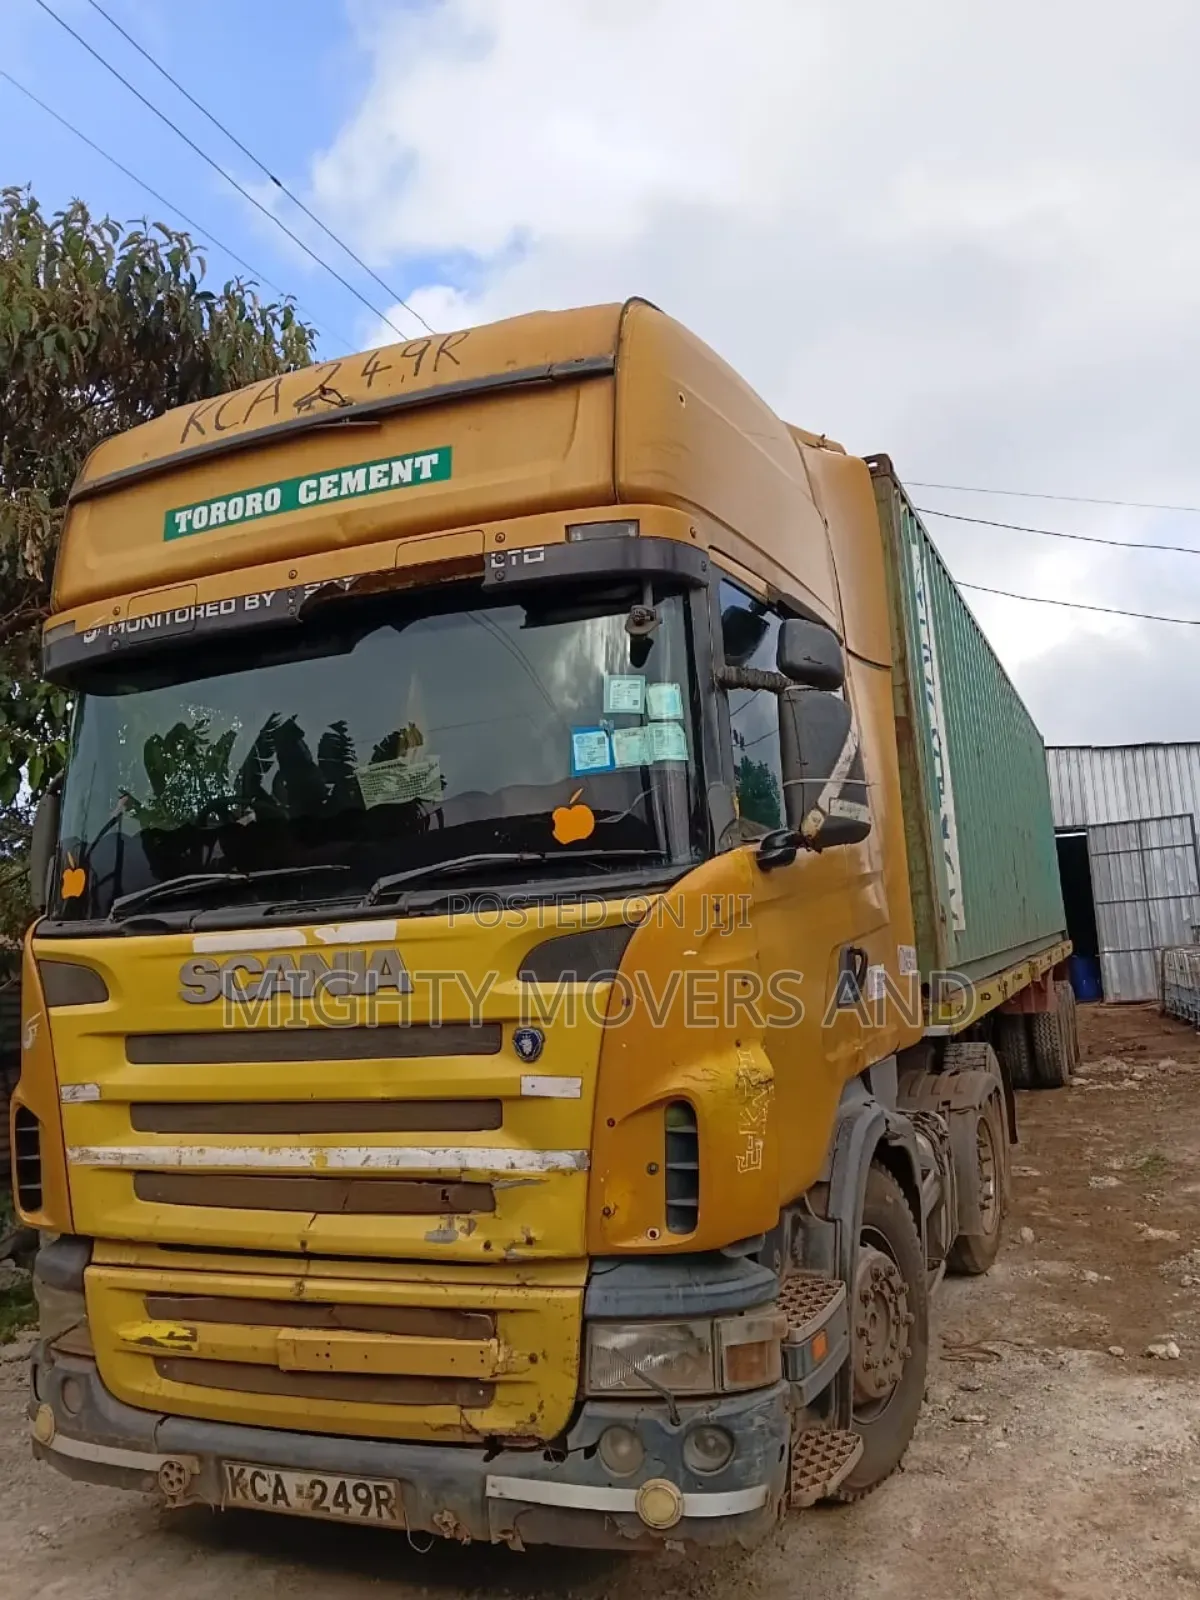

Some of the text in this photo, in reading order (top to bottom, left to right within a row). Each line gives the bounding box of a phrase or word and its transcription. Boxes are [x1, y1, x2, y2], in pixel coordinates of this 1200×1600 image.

[179, 377, 283, 444] KCA
[174, 453, 439, 534] TORORO CEMENT
[244, 591, 276, 611] BY
[179, 948, 414, 1005] SCANIA
[227, 1465, 397, 1521] KCA 249R
